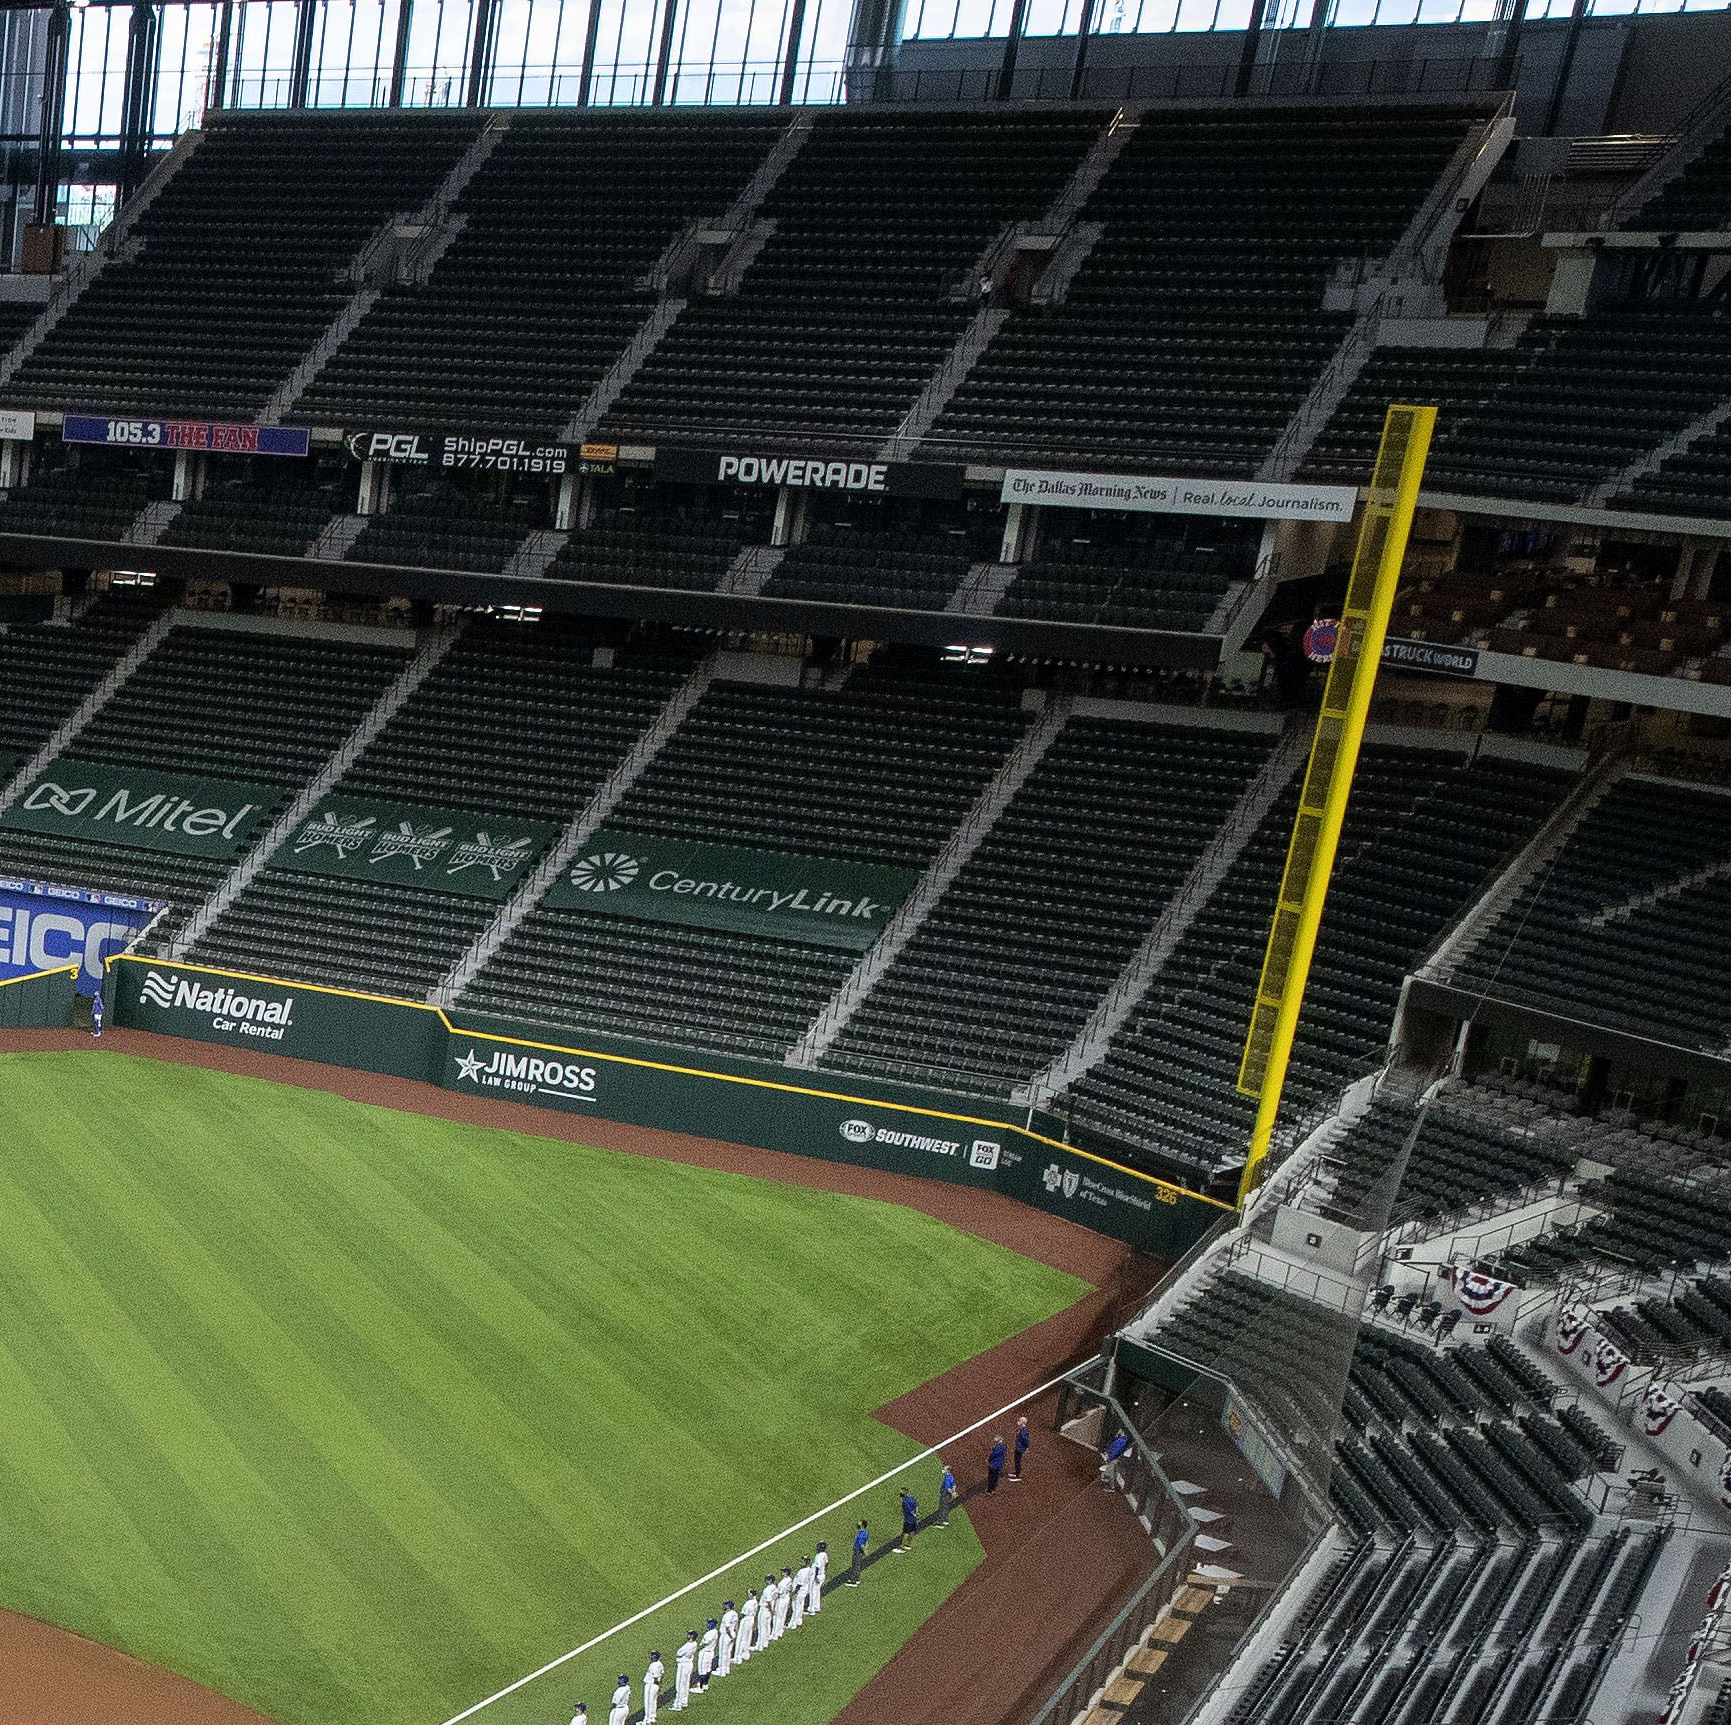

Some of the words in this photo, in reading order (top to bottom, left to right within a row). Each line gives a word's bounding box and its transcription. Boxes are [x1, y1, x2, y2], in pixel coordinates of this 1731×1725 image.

[106, 421, 160, 444] 105.3
[166, 424, 208, 447] THE
[211, 426, 259, 450] FAN
[368, 434, 428, 459] PGL
[444, 437, 567, 459] ShipPGL.com
[442, 454, 566, 473] 877.701.1919
[718, 456, 888, 490] POWERADE
[1012, 478, 1036, 493] The
[1037, 479, 1076, 496] Dallas
[1077, 482, 1132, 500] Morning
[1134, 486, 1167, 500] News
[99, 788, 252, 841] Mitel
[306, 822, 335, 832] BUD
[335, 826, 372, 838] LIGHT
[297, 831, 361, 850] HOMERS
[381, 832, 413, 843] BUD
[412, 836, 449, 848] LIGHT
[371, 842, 438, 860] HOMERS
[459, 842, 491, 853] BUD
[490, 846, 528, 858] LIGHT
[449, 852, 517, 871] HOMERS
[47, 887, 79, 899] GEICO
[104, 896, 137, 909] GEICO
[648, 871, 883, 920] CenturyLink
[212, 1016, 245, 1033] Car
[247, 1021, 285, 1040] Rental
[482, 1076, 503, 1087] LAW
[504, 1079, 537, 1094] GROUP
[847, 1123, 869, 1135] FOX
[875, 1128, 960, 1156] SOUTHWEST
[976, 1144, 996, 1153] FOX
[975, 1156, 992, 1166] GO
